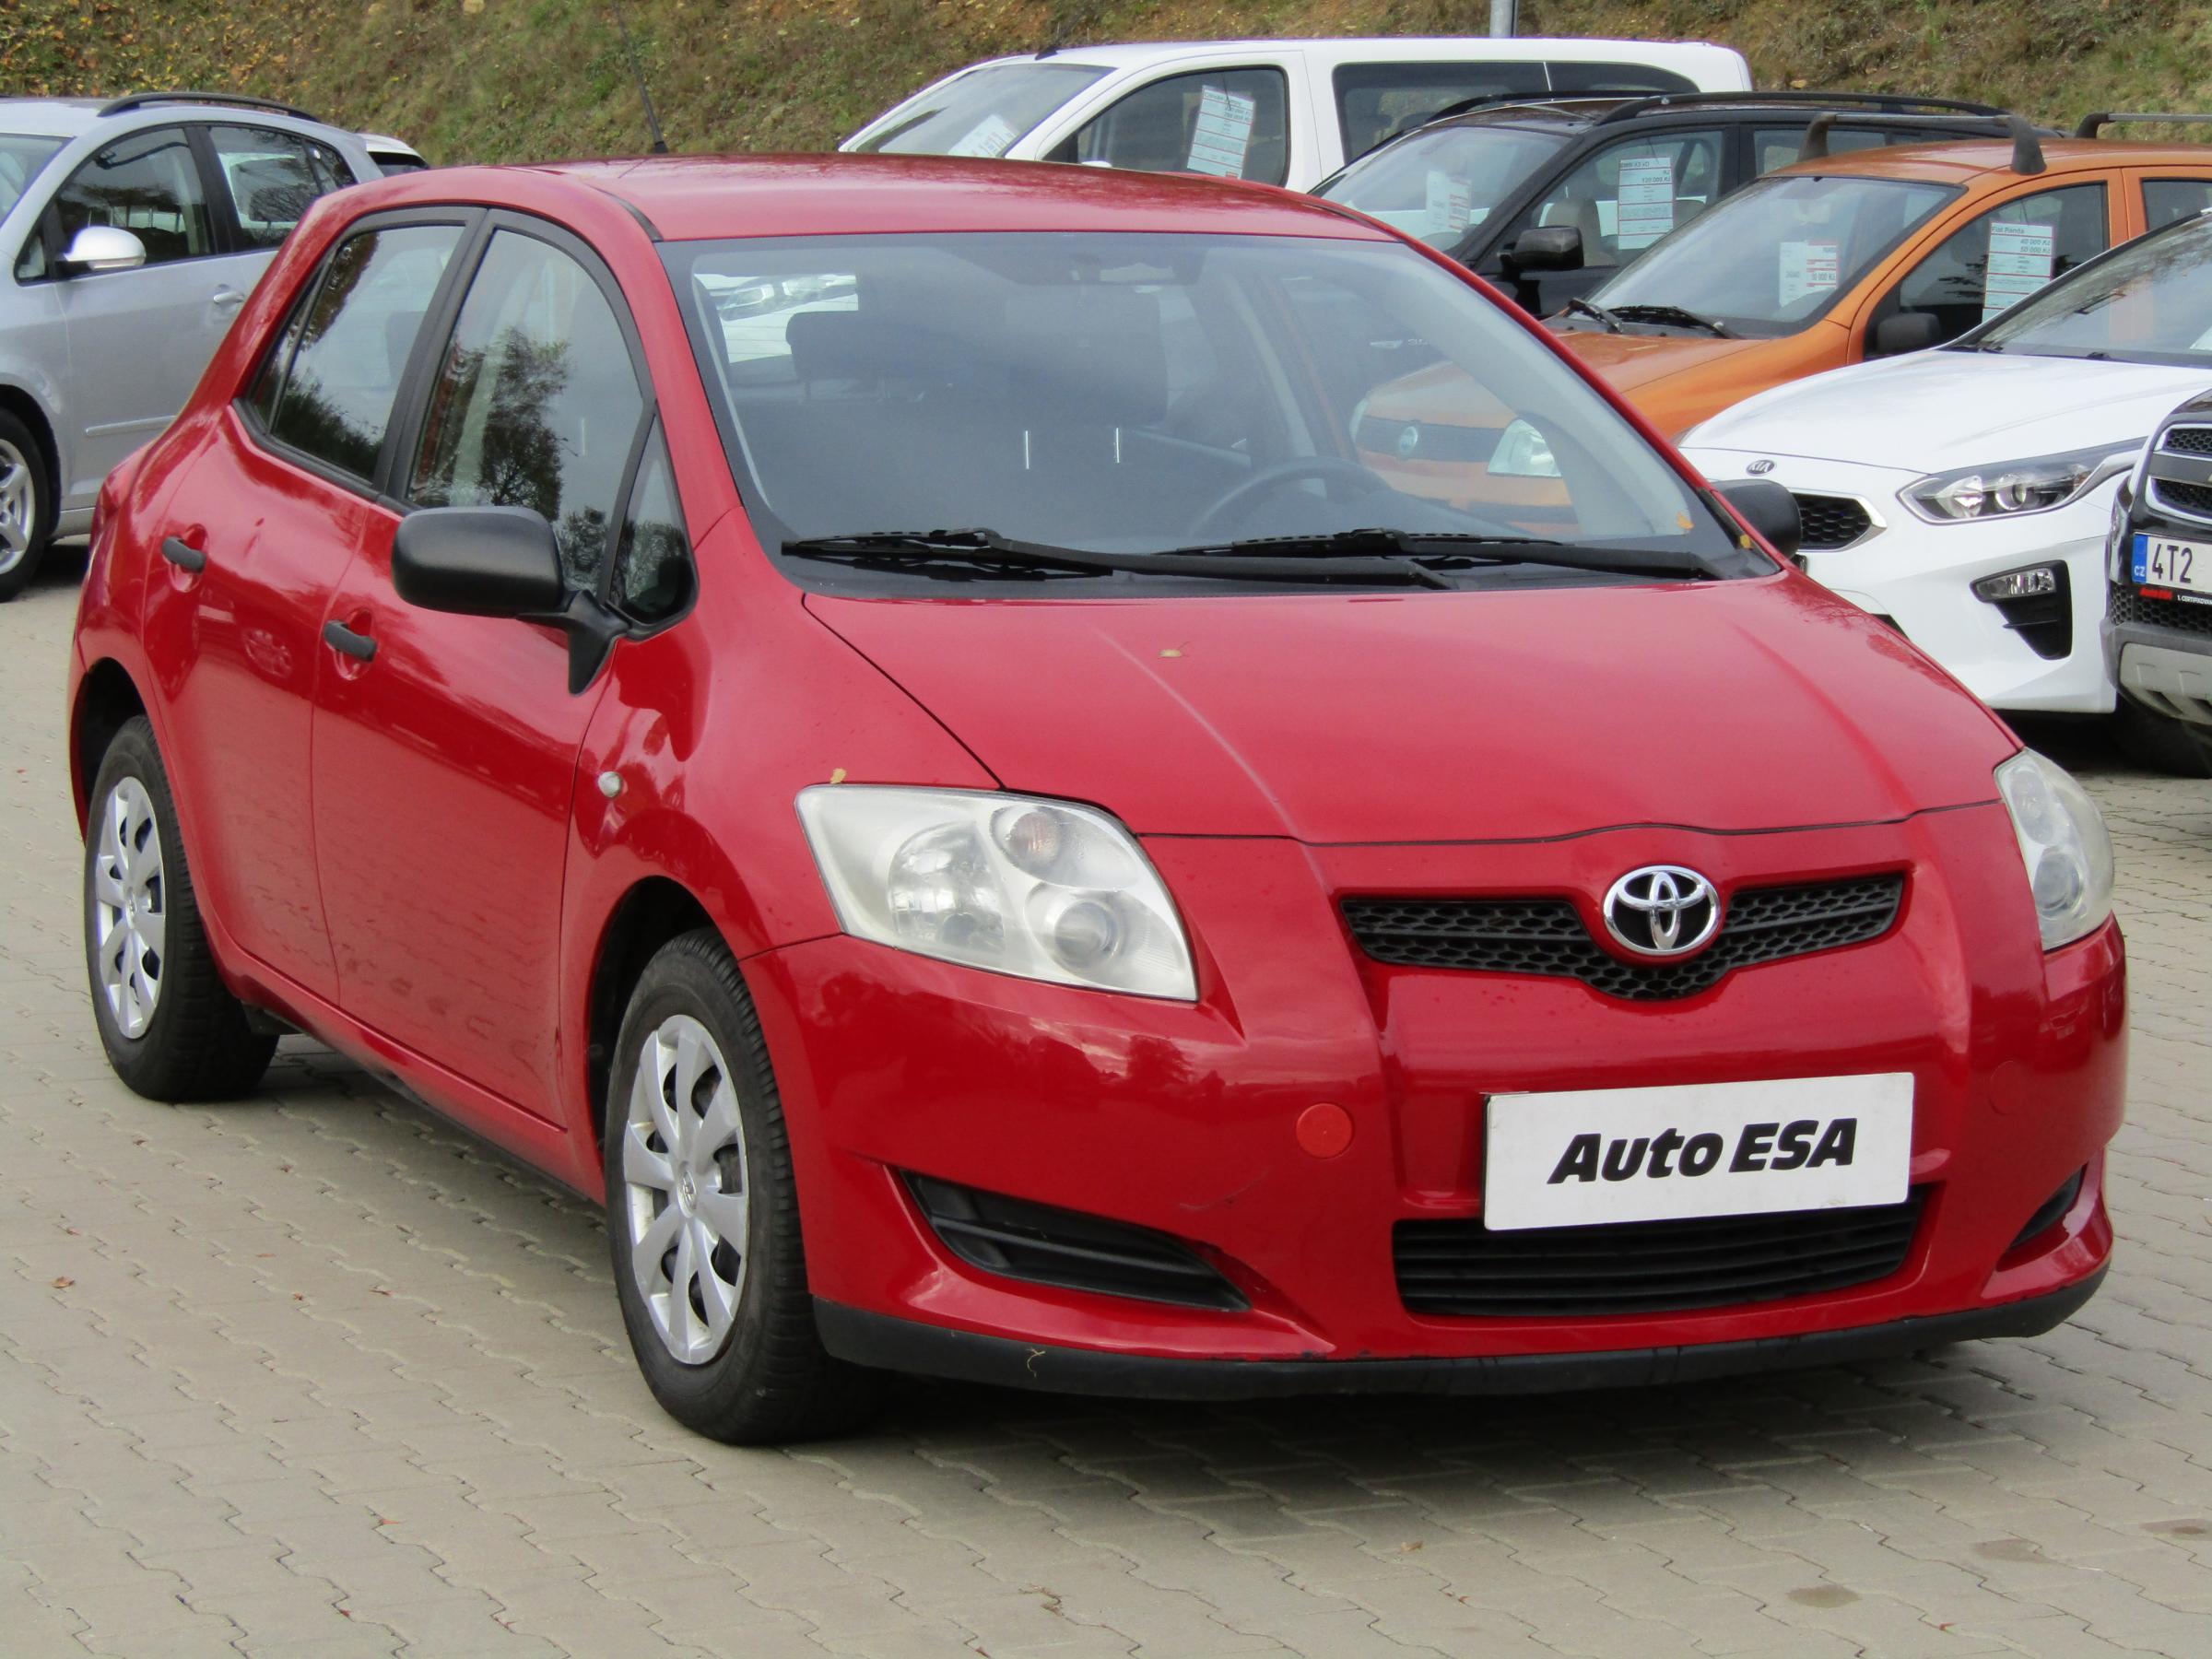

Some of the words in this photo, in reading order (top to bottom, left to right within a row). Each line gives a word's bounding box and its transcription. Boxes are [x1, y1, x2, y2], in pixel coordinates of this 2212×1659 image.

[2134, 565, 2146, 577] CZ
[2151, 543, 2193, 583] 4T2
[1547, 1127, 1724, 1185] Auto
[1728, 1117, 1858, 1173] ESA
